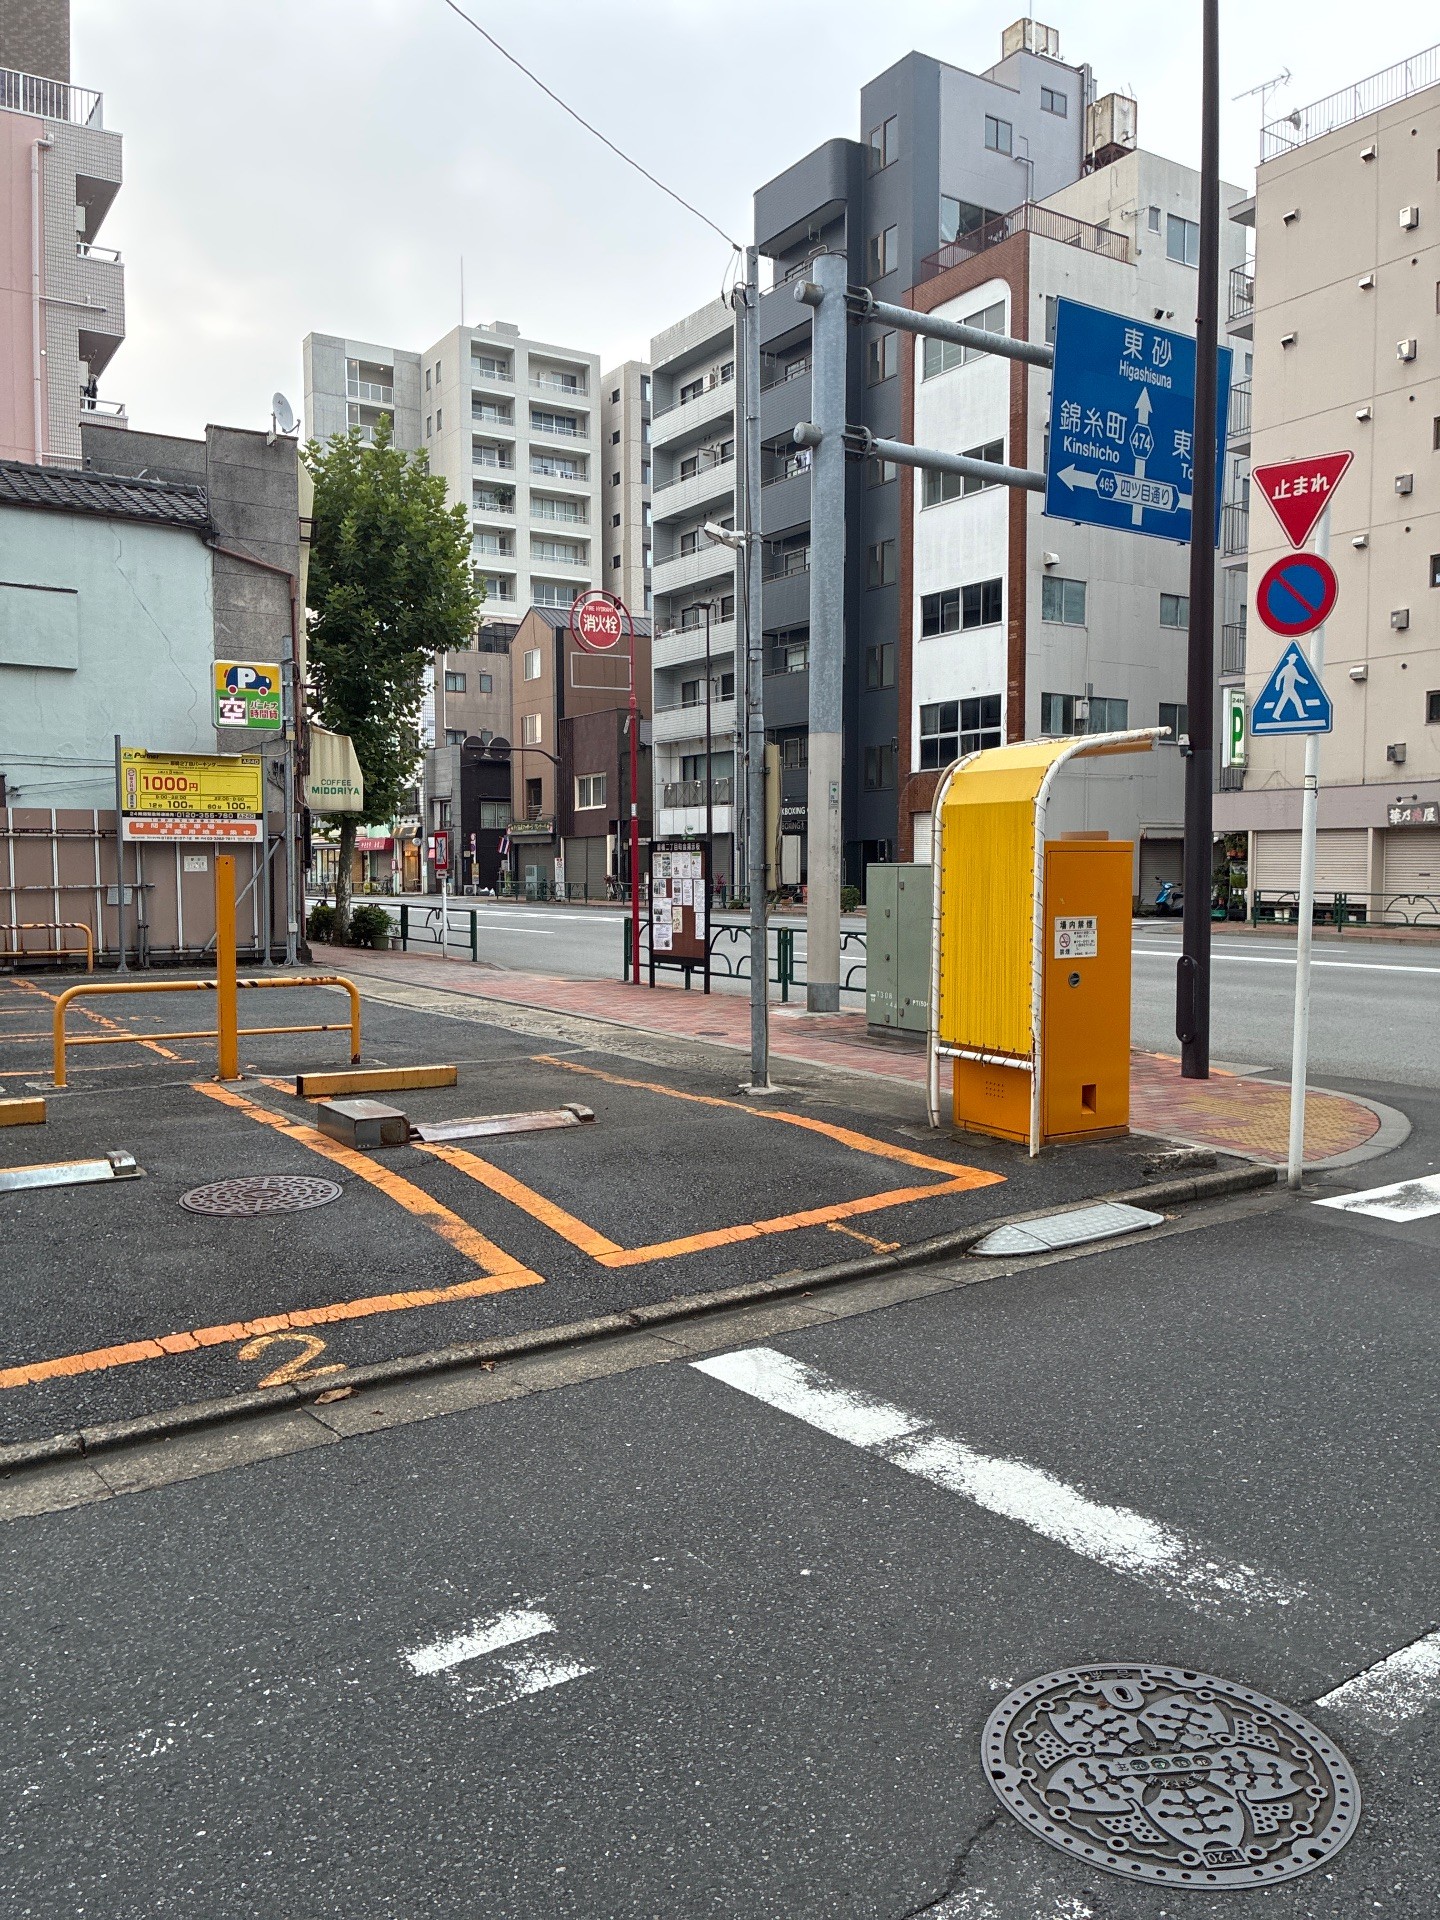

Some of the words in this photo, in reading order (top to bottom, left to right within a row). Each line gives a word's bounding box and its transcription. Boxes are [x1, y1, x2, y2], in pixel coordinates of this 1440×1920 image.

[1122, 327, 1172, 367] 東砂
[1119, 359, 1172, 389] Higashisuna
[1059, 400, 1127, 444] 錦糸町
[1063, 435, 1120, 463] Kinshicho
[1132, 432, 1151, 451] 474
[1099, 477, 1115, 492] 465
[1120, 479, 1171, 506] 四ツ目通り
[1272, 472, 1330, 500] 止まれ
[583, 613, 618, 634] 消火栓
[237, 667, 256, 688] P
[219, 697, 246, 720] 空
[1232, 706, 1243, 758] P
[311, 786, 360, 796] MIDORIYA
[320, 779, 352, 787] COFFEE
[1060, 919, 1093, 930] 場内禁煙
[237, 1333, 347, 1390] 2
[1206, 1850, 1243, 1864] T-20
